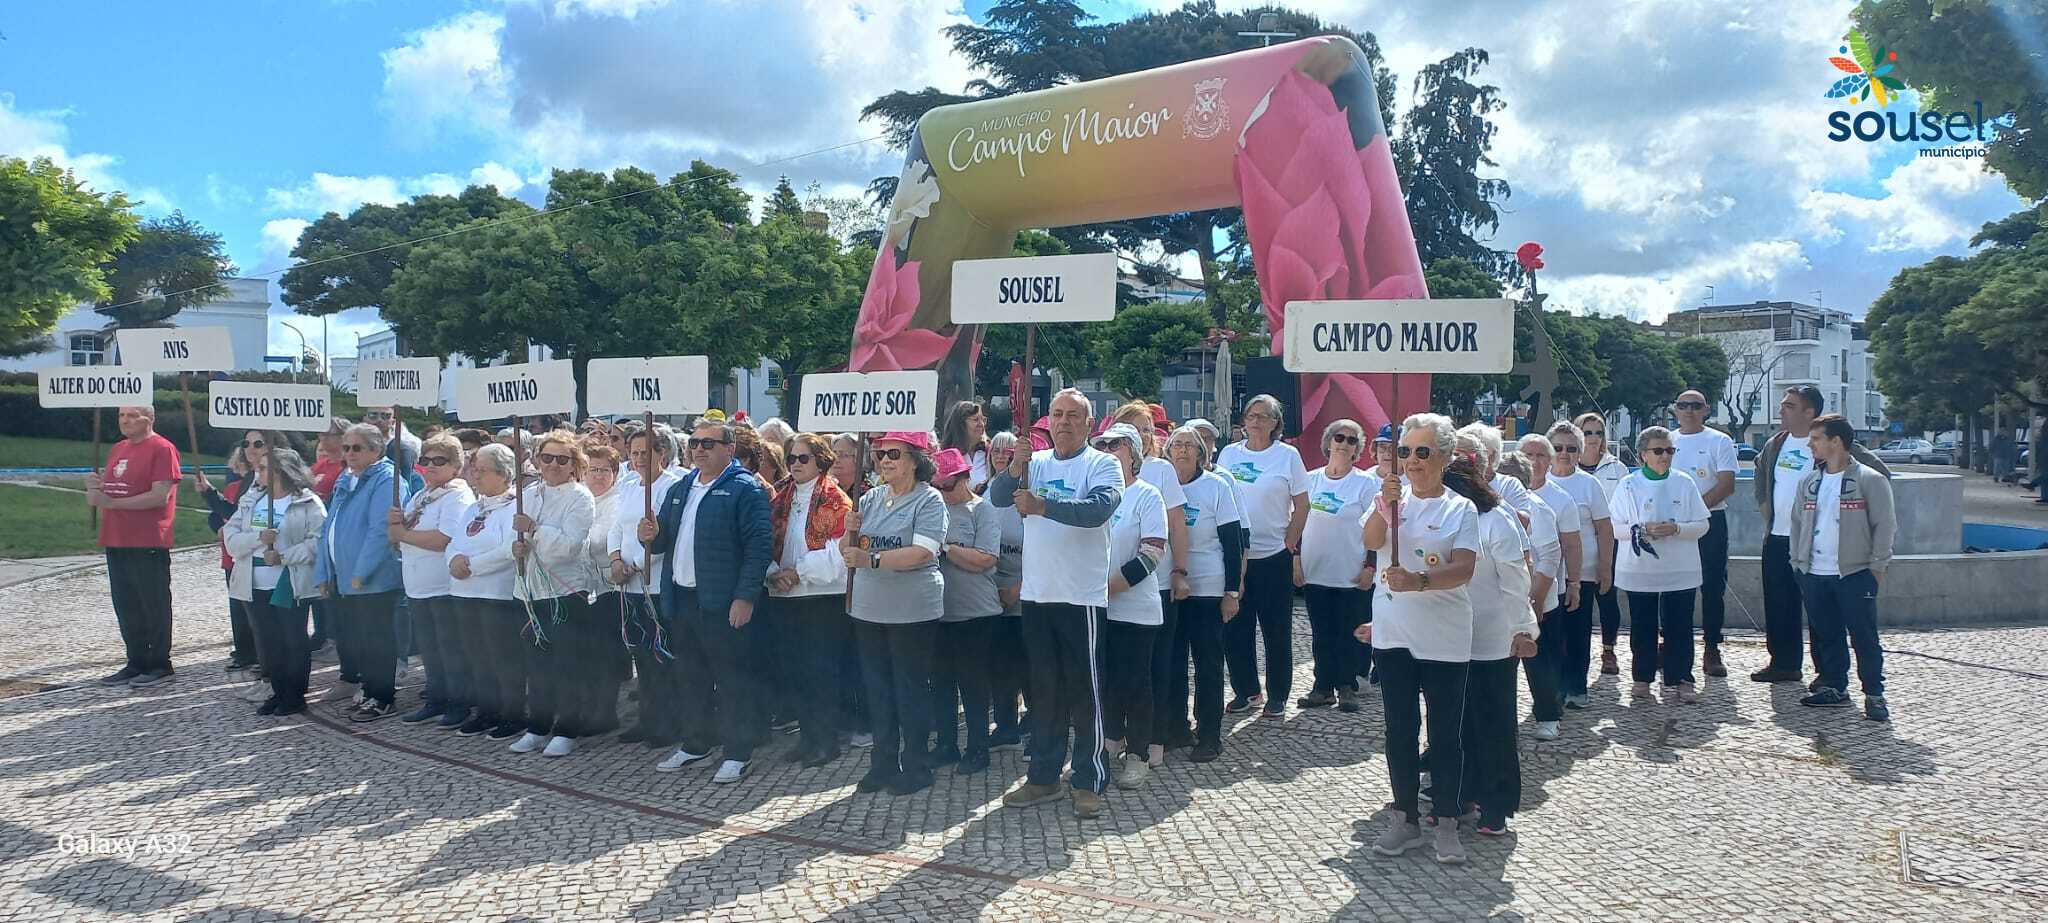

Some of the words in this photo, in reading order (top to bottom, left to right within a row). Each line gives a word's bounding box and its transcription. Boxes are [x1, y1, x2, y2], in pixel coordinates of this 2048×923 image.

[948, 127, 1056, 177] Campo
[1062, 103, 1173, 154] Maior
[998, 276, 1065, 304] SOUSEL
[1313, 322, 1393, 352] CAMPO
[1400, 322, 1479, 352] MAIOR
[163, 341, 189, 359] AVIS
[48, 377, 85, 395] ALTER
[88, 377, 105, 394] DO
[108, 372, 142, 394] CHÃO
[374, 370, 421, 391] FRONTEIRA
[487, 373, 538, 404] MARVÃO
[632, 377, 661, 401] NISA
[214, 396, 270, 417] CASTELO
[273, 399, 291, 417] DE
[295, 400, 325, 418] VIDE
[814, 392, 857, 417] PONTE
[861, 391, 881, 416] DE
[885, 390, 916, 416] SOR
